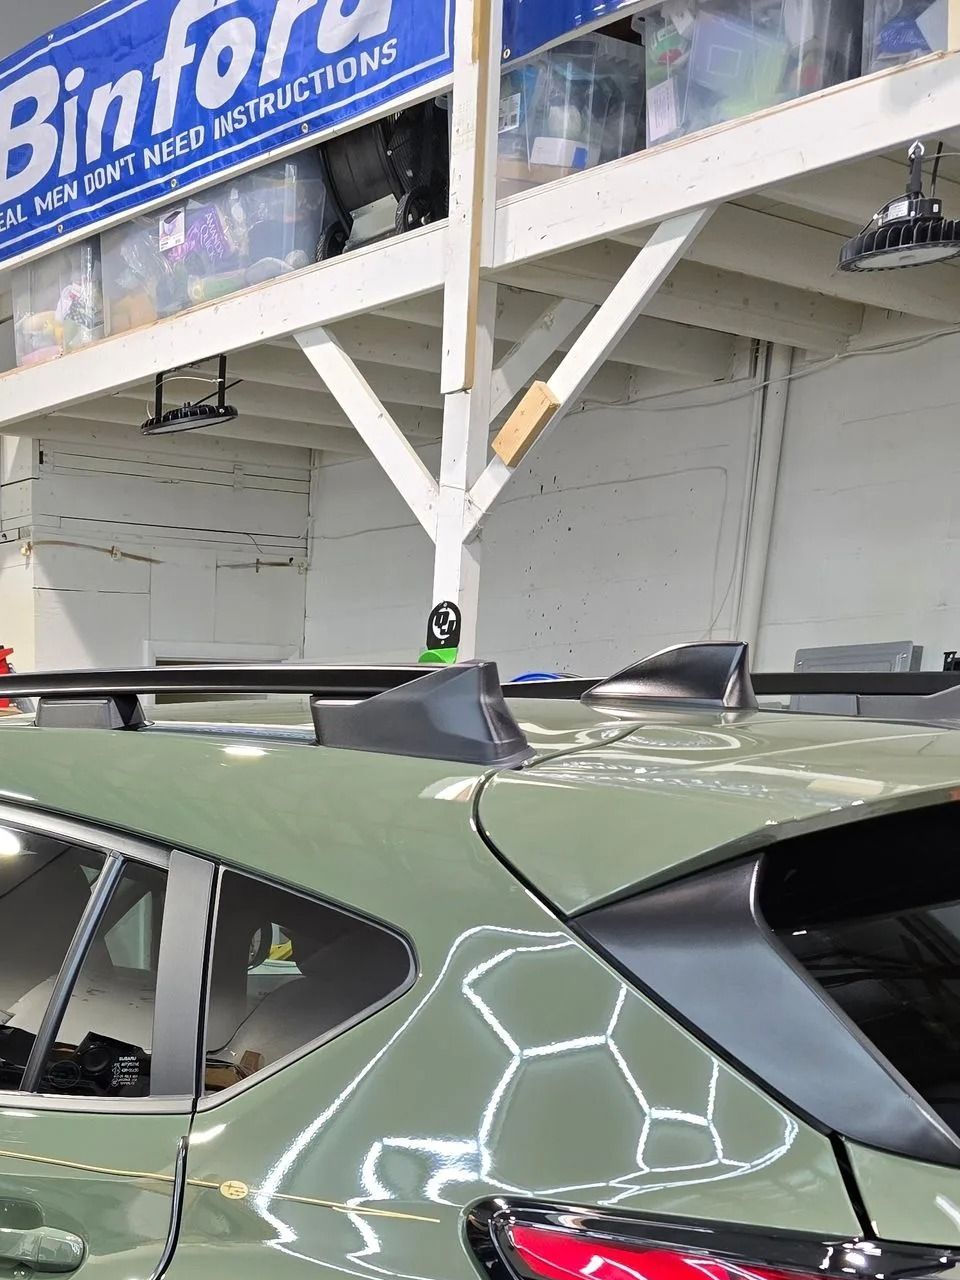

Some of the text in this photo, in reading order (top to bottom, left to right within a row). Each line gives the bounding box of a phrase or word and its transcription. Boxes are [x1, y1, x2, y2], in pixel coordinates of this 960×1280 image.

[34, 181, 79, 216] MEN
[84, 152, 136, 195] DON'T
[144, 125, 205, 168] NEED
[213, 37, 399, 139] INSTRUCTIONS
